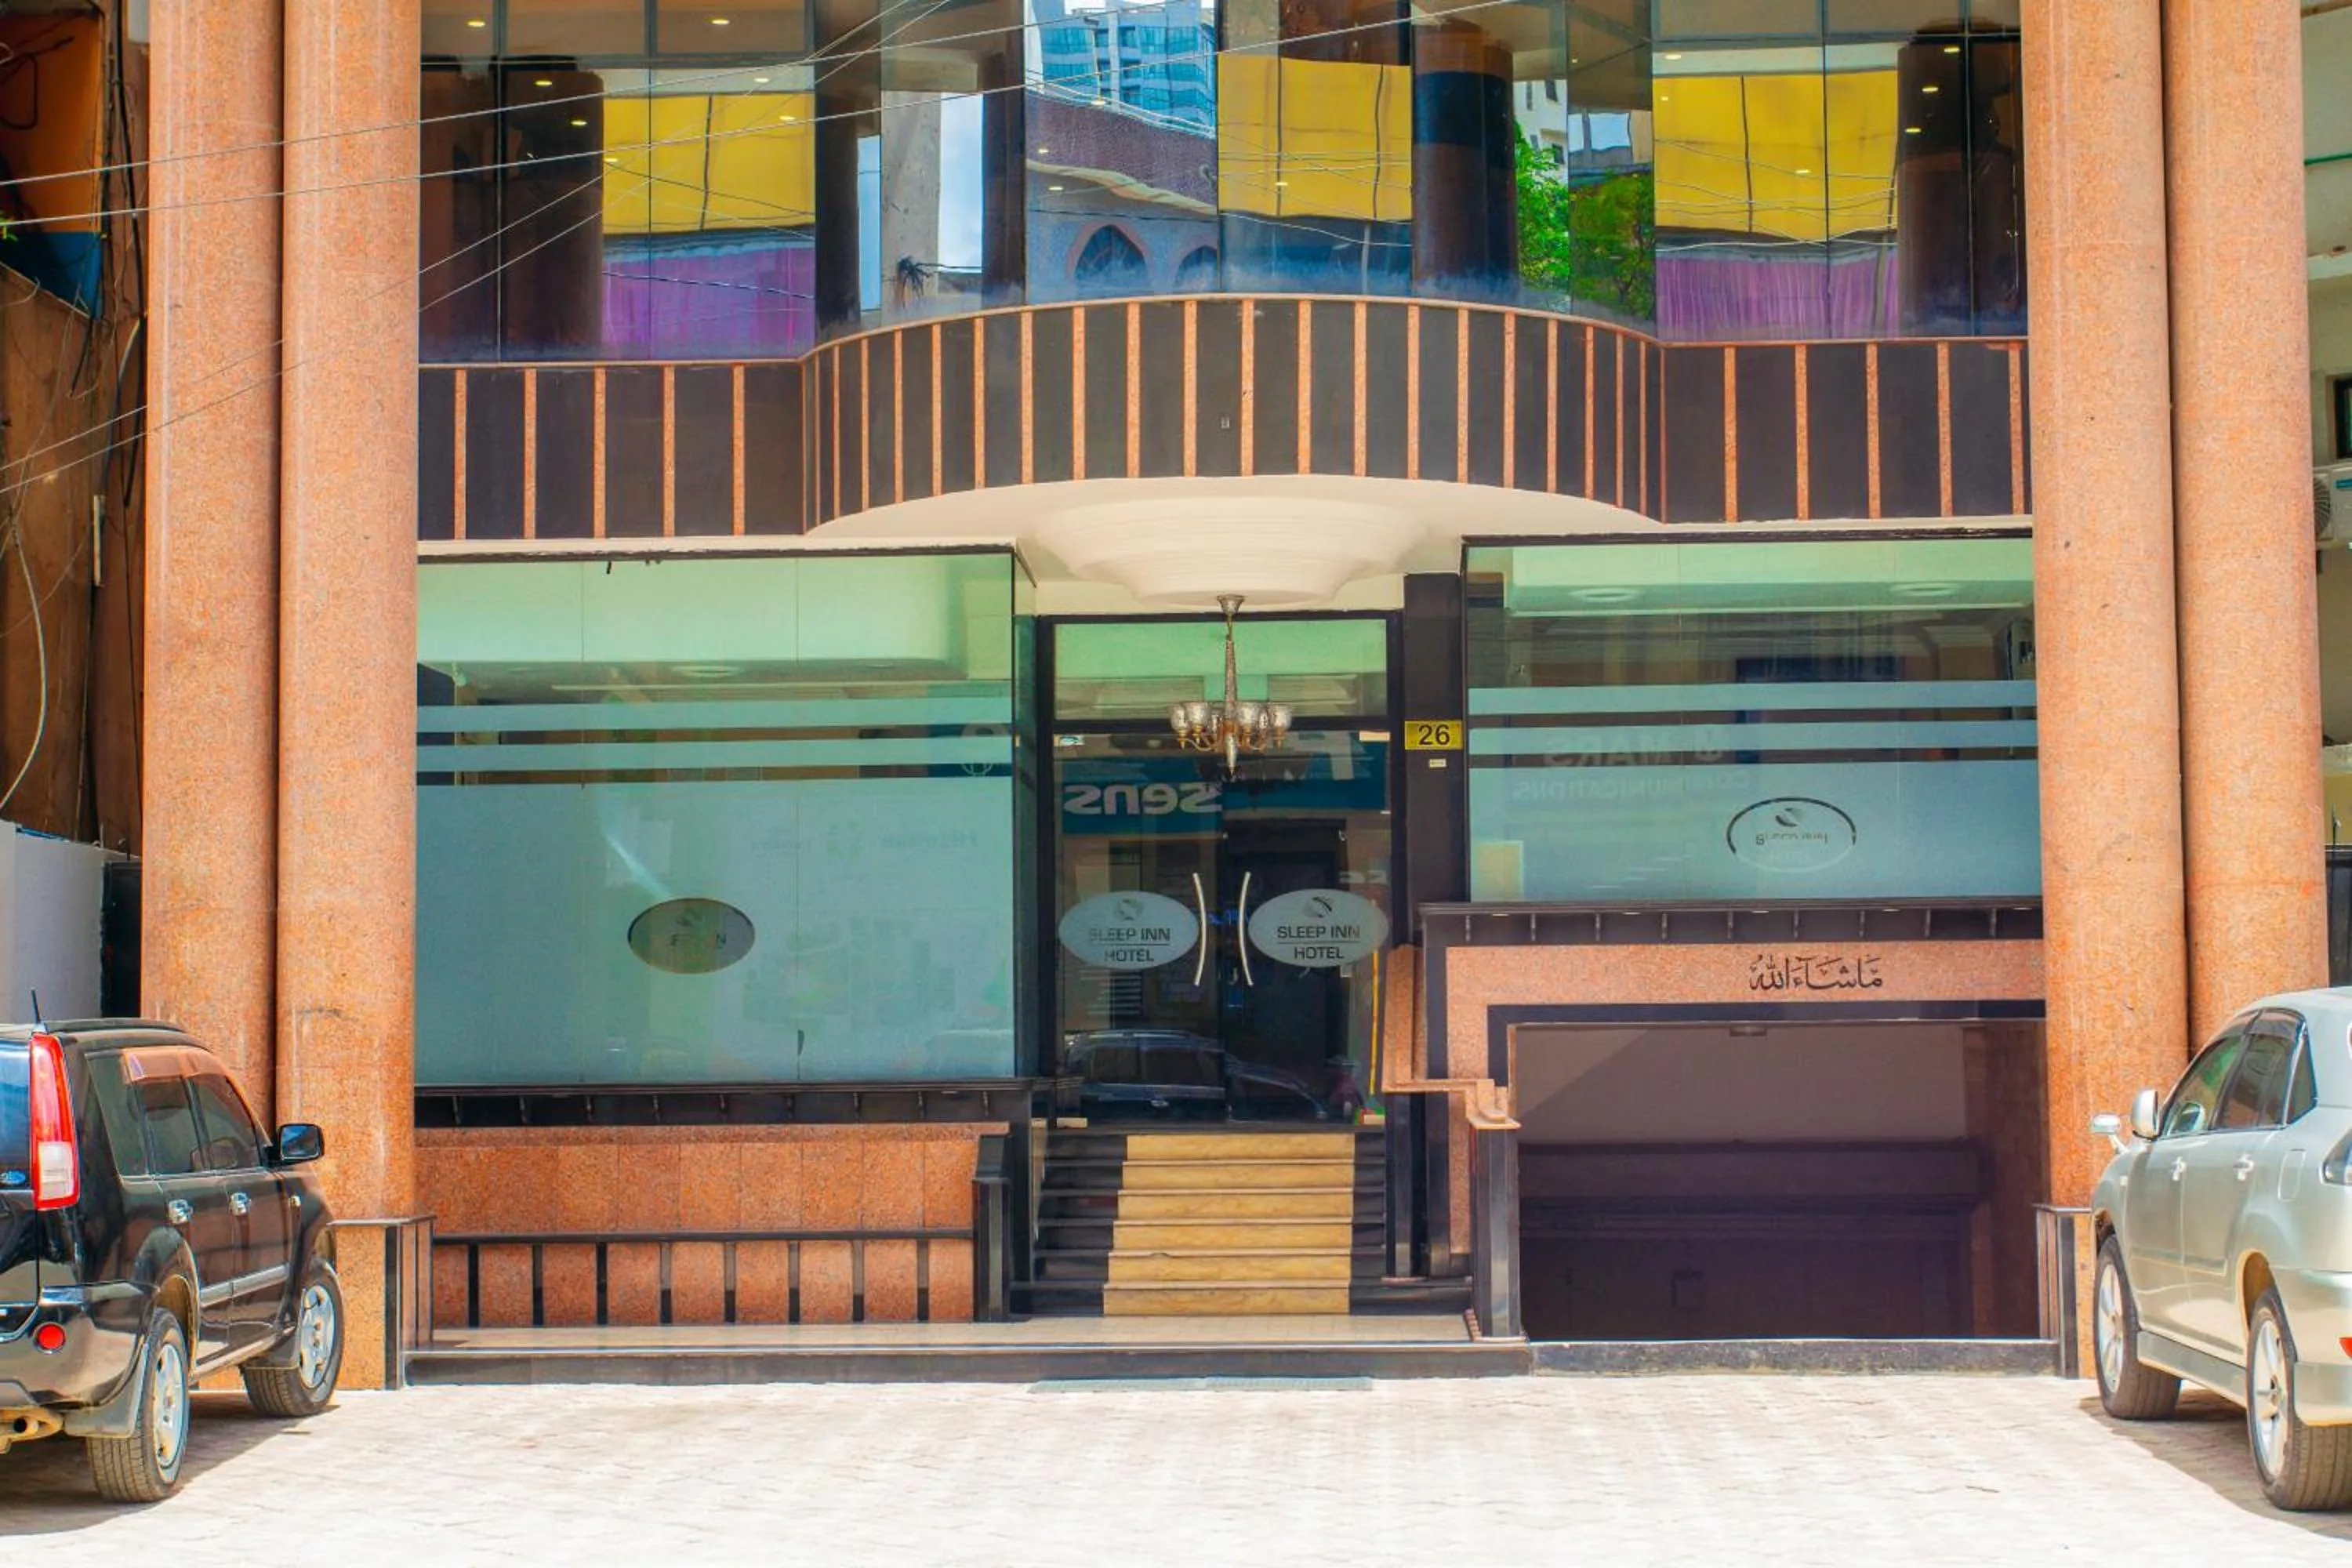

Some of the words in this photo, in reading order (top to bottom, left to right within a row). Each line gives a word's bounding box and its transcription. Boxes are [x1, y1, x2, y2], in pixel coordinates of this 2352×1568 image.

[1418, 724, 1450, 746] 26
[1088, 927, 1137, 942] SLEEP
[1141, 927, 1171, 942] INN
[1277, 925, 1326, 938] SLEEP
[1330, 925, 1360, 938] INN
[1104, 949, 1154, 962] HOTEL
[1294, 946, 1345, 959] HOTEL
